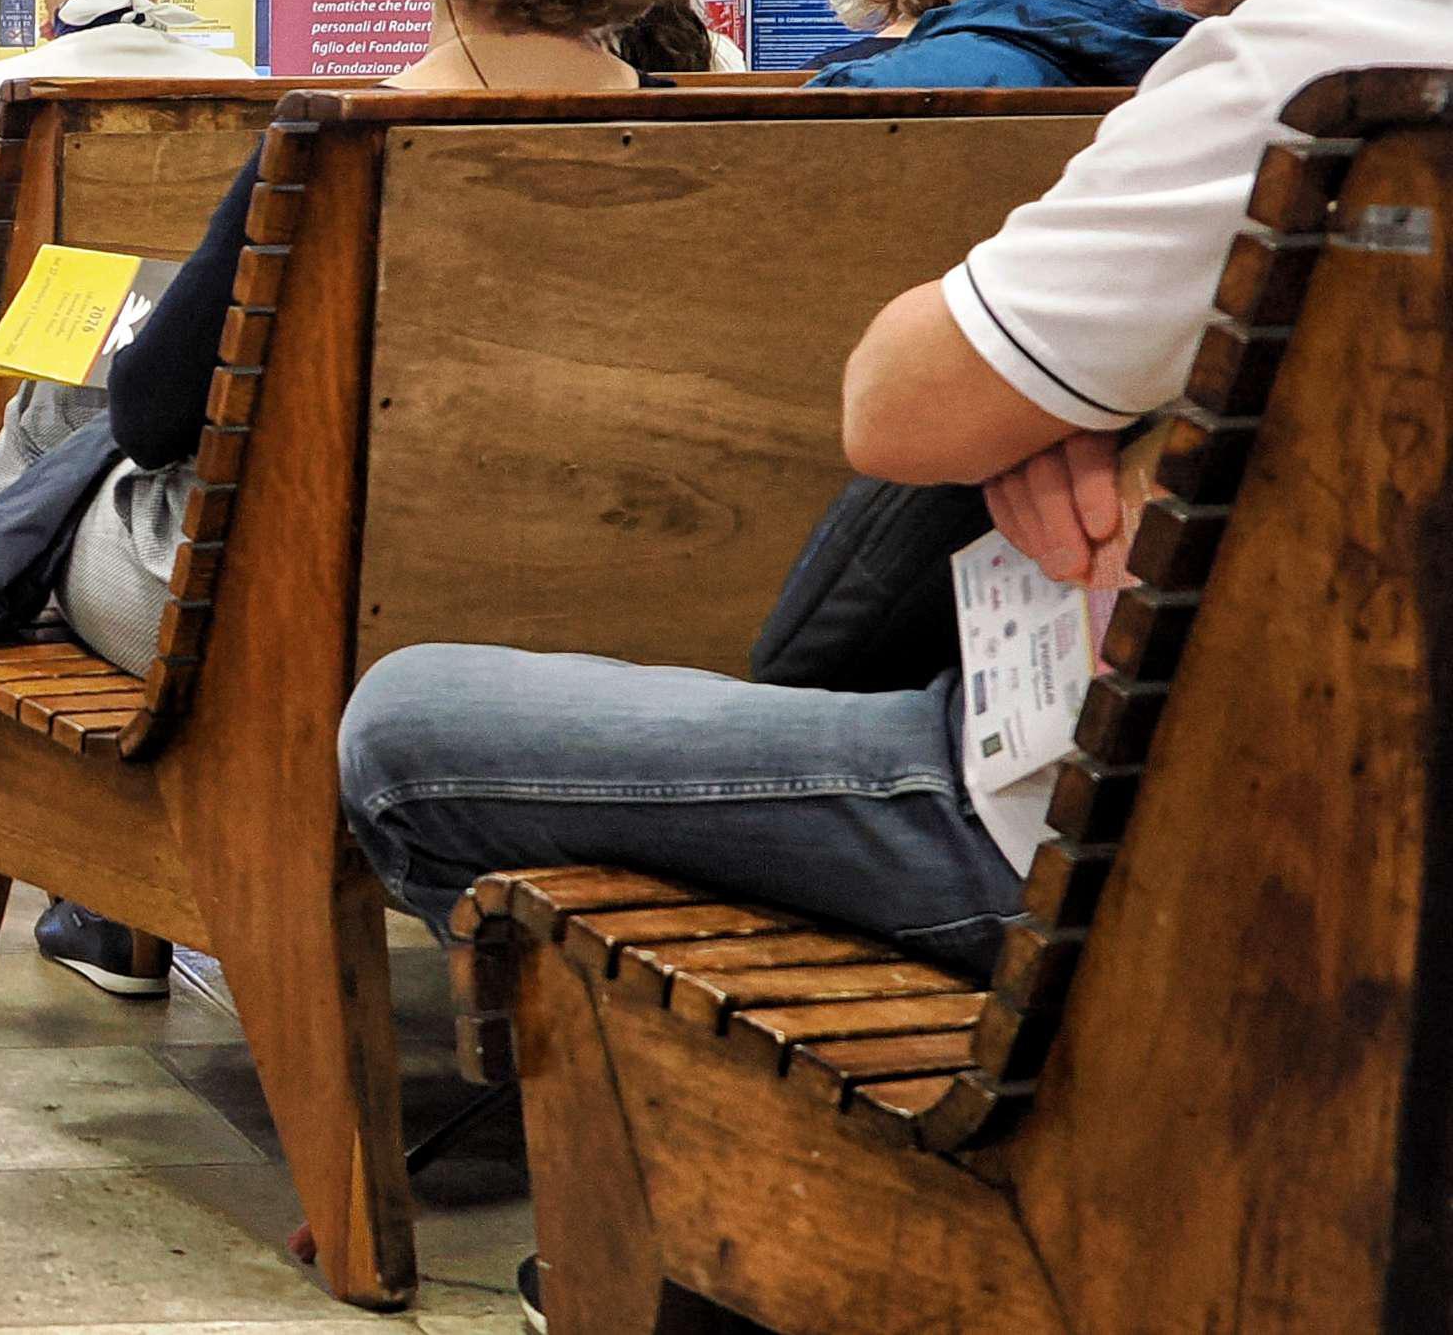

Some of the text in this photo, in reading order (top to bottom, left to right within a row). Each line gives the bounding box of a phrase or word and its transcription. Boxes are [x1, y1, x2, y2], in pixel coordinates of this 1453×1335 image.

[312, 0, 435, 13] tematiche che furo
[311, 20, 432, 36] personali di Robert
[312, 41, 345, 56] figlio
[368, 40, 428, 53] Fondator
[311, 62, 324, 75] la
[327, 61, 401, 75] Fondazione
